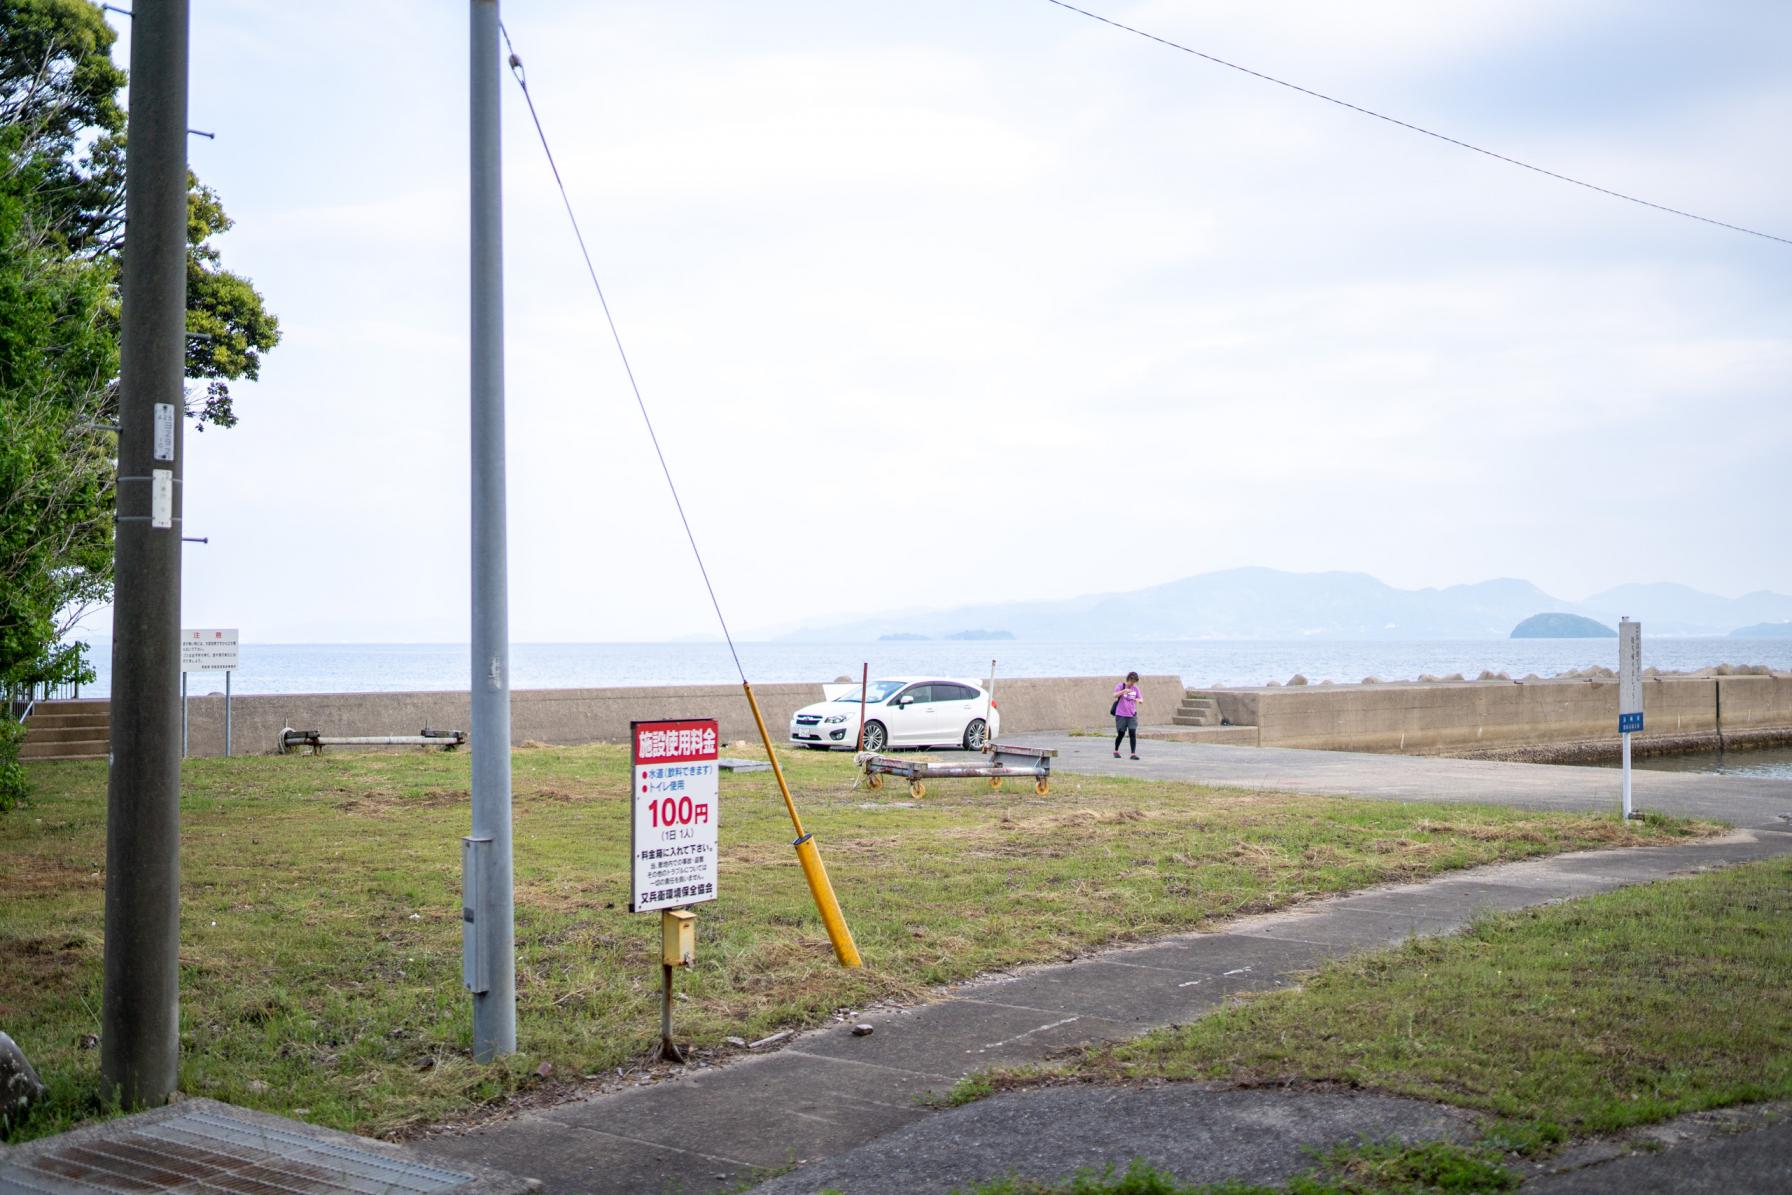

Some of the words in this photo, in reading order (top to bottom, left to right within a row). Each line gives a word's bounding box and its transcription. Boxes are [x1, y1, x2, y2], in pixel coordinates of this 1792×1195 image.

[639, 728, 716, 758] 施設使用料金
[649, 780, 685, 792] トイレ使用
[648, 796, 708, 828] 100円
[641, 844, 713, 860] 料金箱に入れて下さい。
[641, 883, 713, 904] 又兵衛環境保全協会
